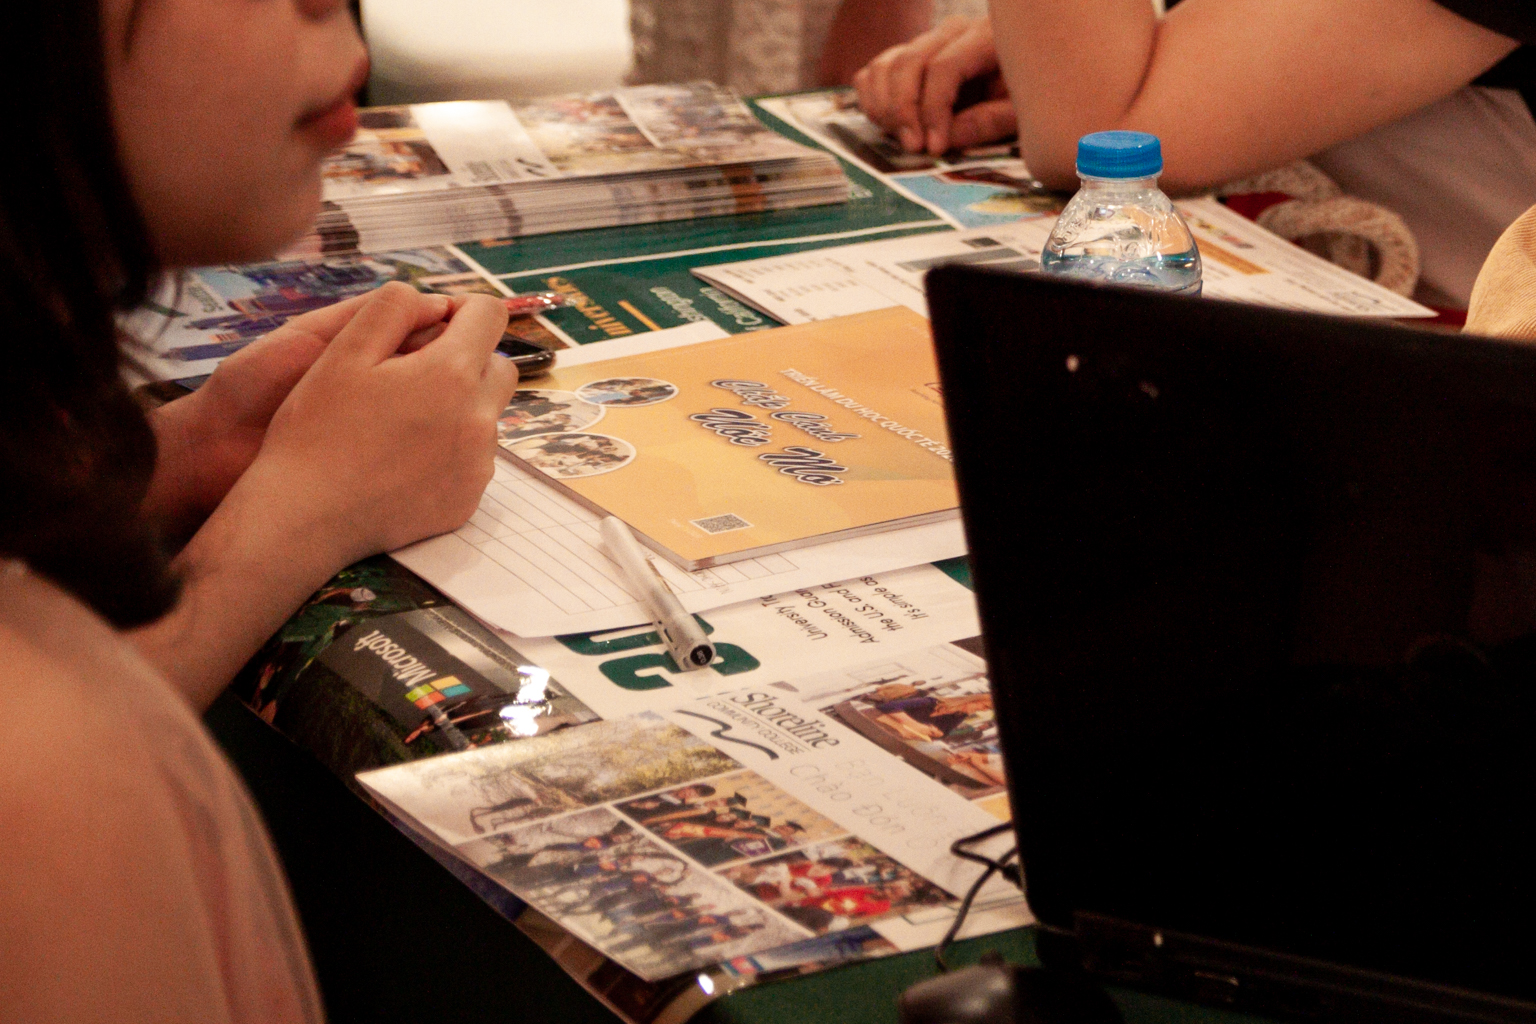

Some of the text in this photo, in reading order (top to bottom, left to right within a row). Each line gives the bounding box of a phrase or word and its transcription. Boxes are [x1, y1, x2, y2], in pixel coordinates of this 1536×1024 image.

[833, 588, 862, 604] and
[872, 586, 914, 610] simple
[775, 605, 828, 641] University
[823, 607, 881, 644] Admission
[880, 617, 903, 632] the
[353, 629, 437, 687] Microsoft
[706, 701, 804, 755] COMMUNITY COLLEGE
[730, 692, 841, 750] Shoreline
